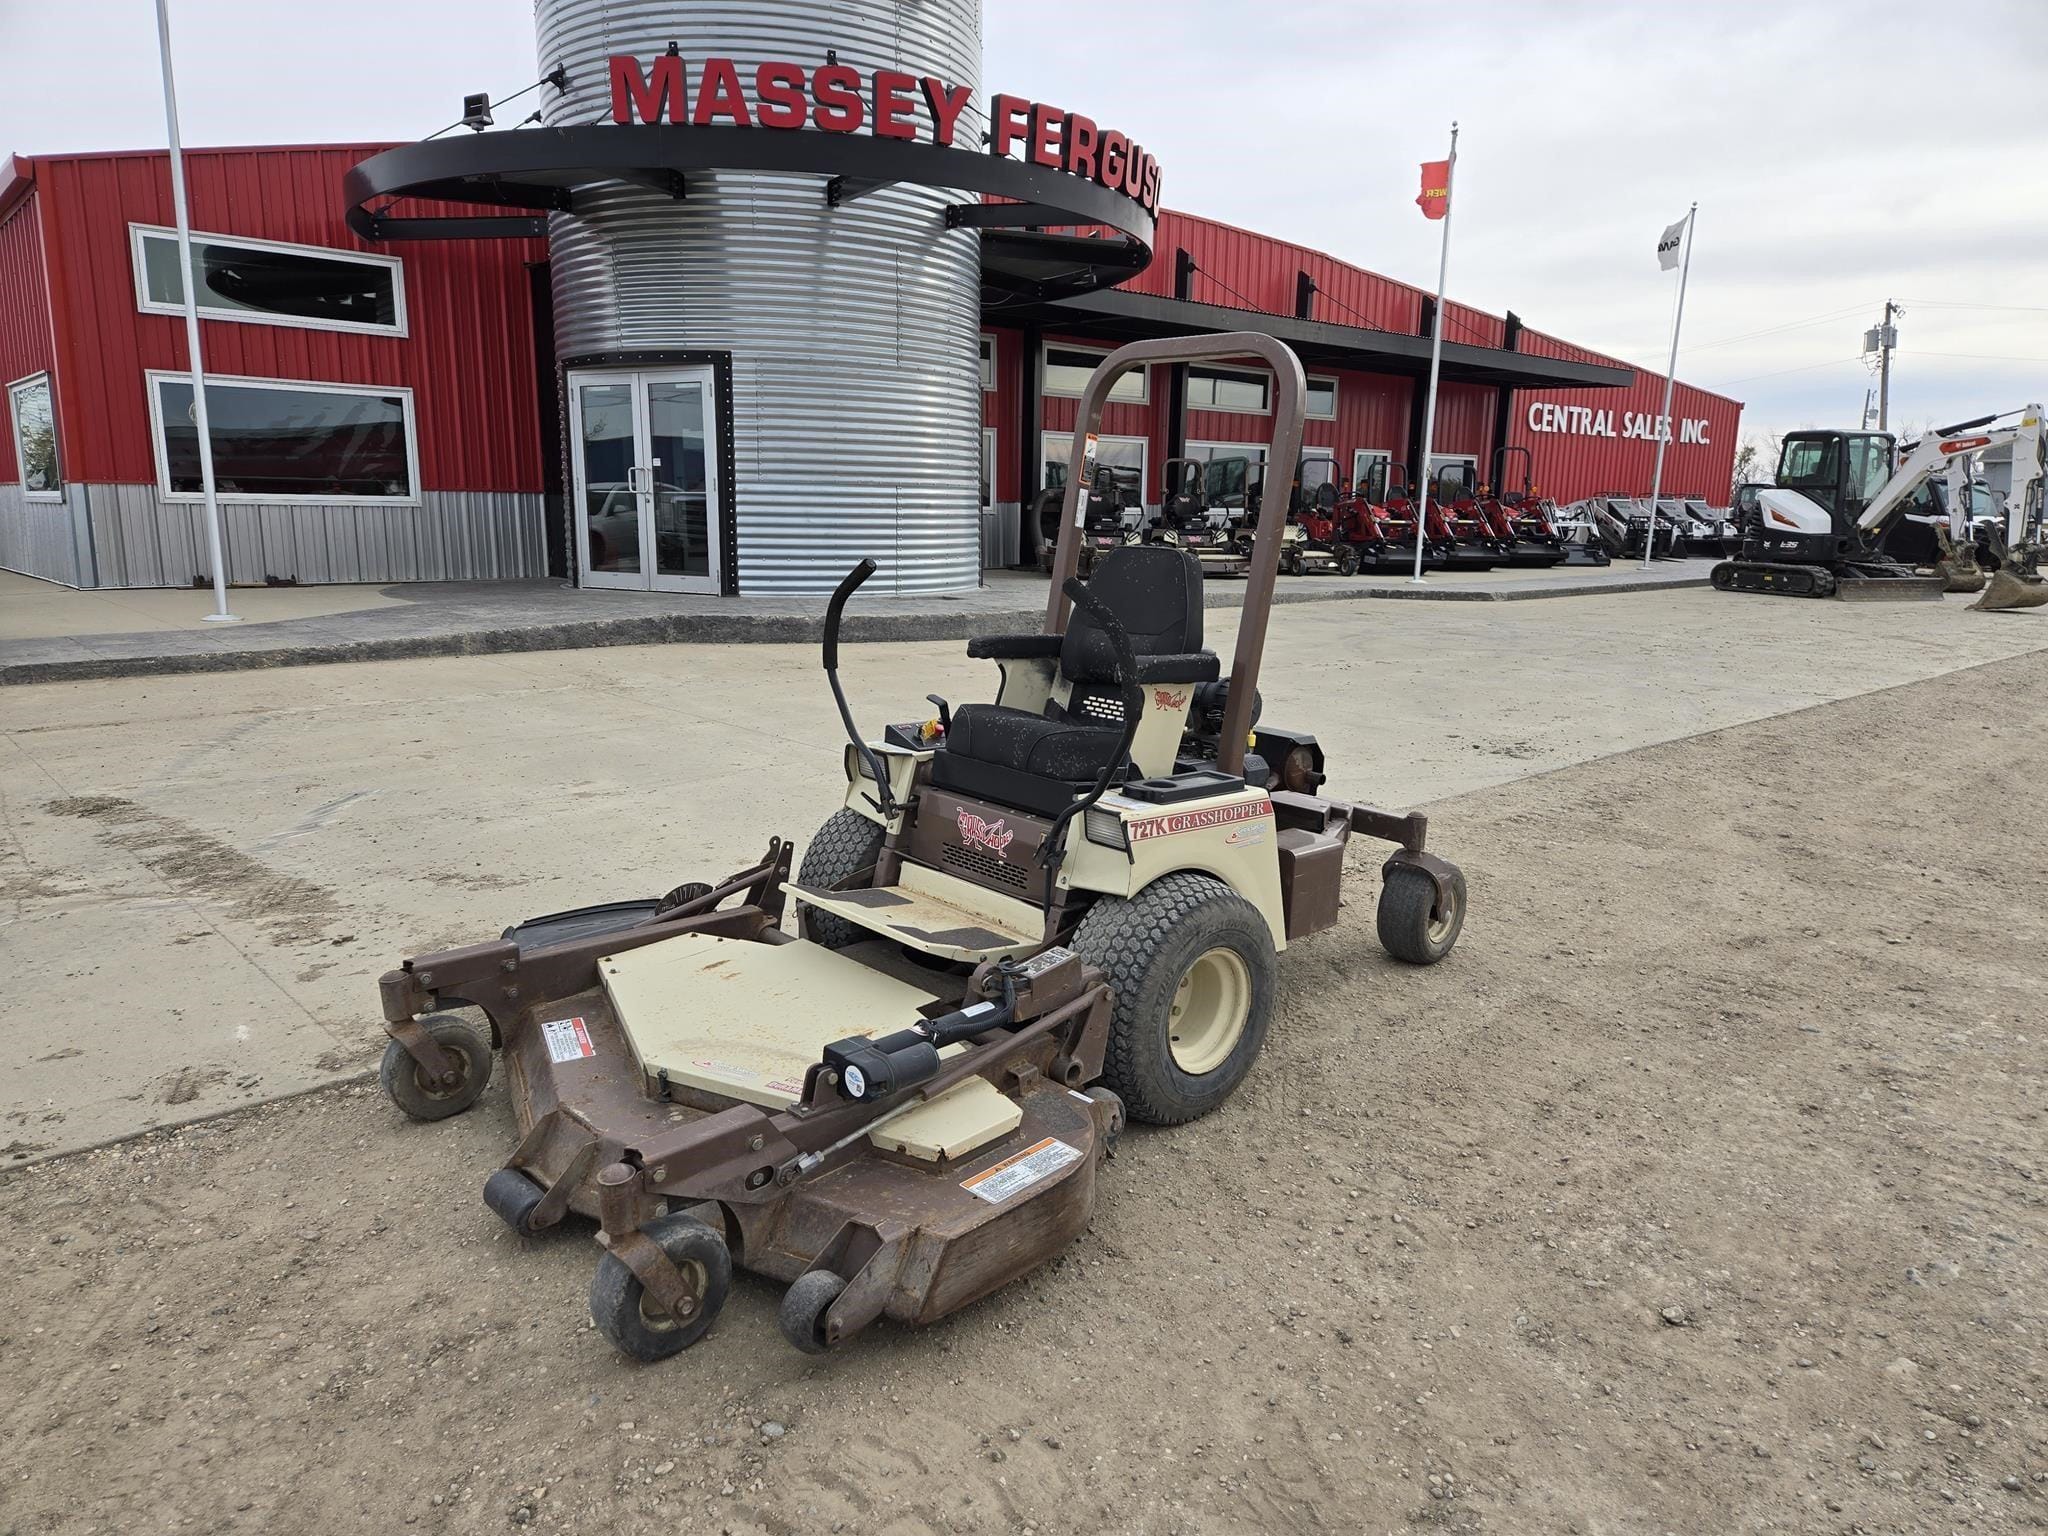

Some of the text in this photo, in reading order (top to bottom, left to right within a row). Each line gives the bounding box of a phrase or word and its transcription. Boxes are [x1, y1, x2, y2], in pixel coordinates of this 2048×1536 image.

[609, 55, 973, 147] MASSEY
[1528, 402, 1616, 438] CENTRAL
[1680, 418, 1710, 445] INC.
[1130, 802, 1265, 839] 727K GRASSHOPPER
